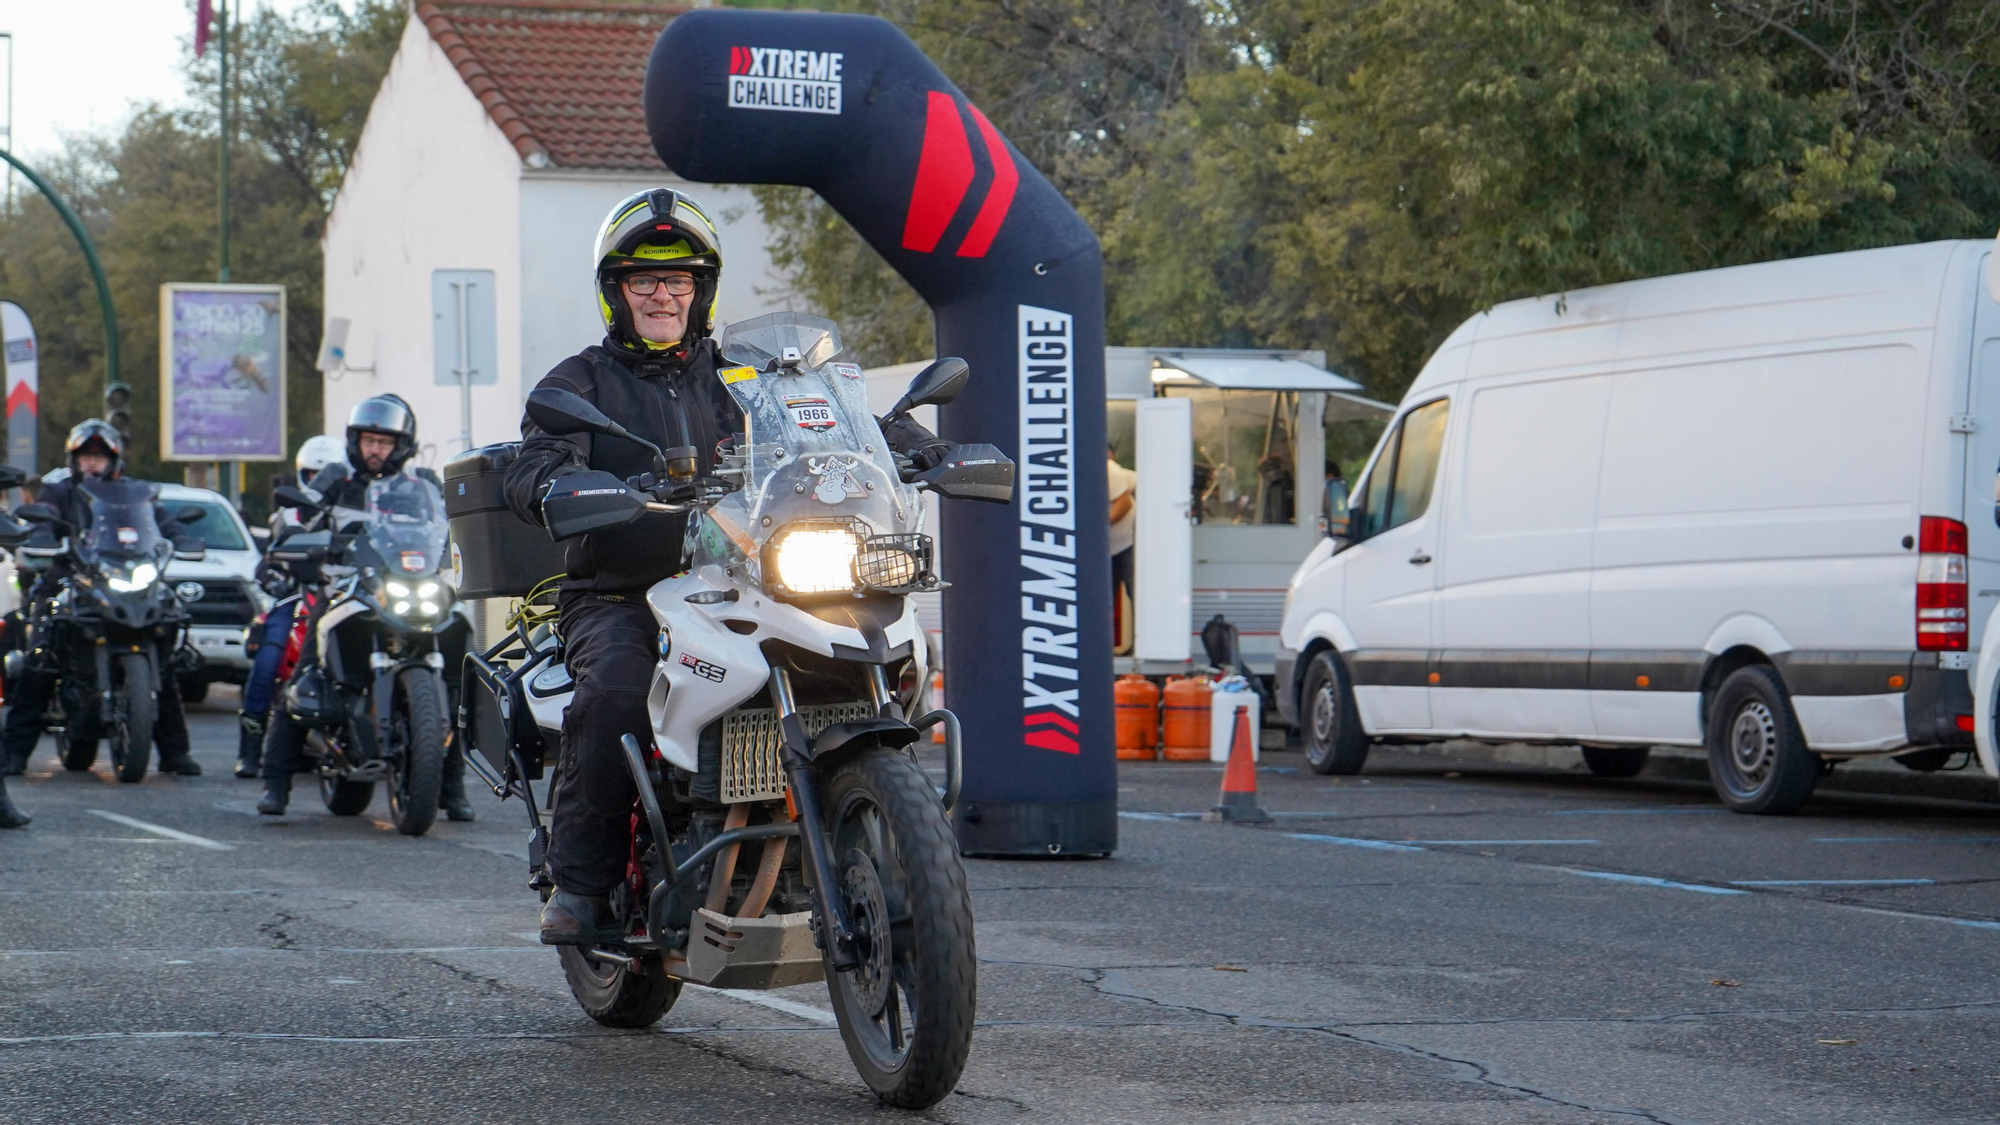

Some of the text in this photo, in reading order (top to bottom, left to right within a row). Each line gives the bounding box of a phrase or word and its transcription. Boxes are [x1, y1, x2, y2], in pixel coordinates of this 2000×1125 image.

[748, 47, 844, 82] XTREME
[734, 80, 837, 110] CHALLENGE
[798, 408, 829, 421] 1966
[1020, 319, 1080, 718] XTREME CHALLENGE
[694, 661, 725, 682] GS
